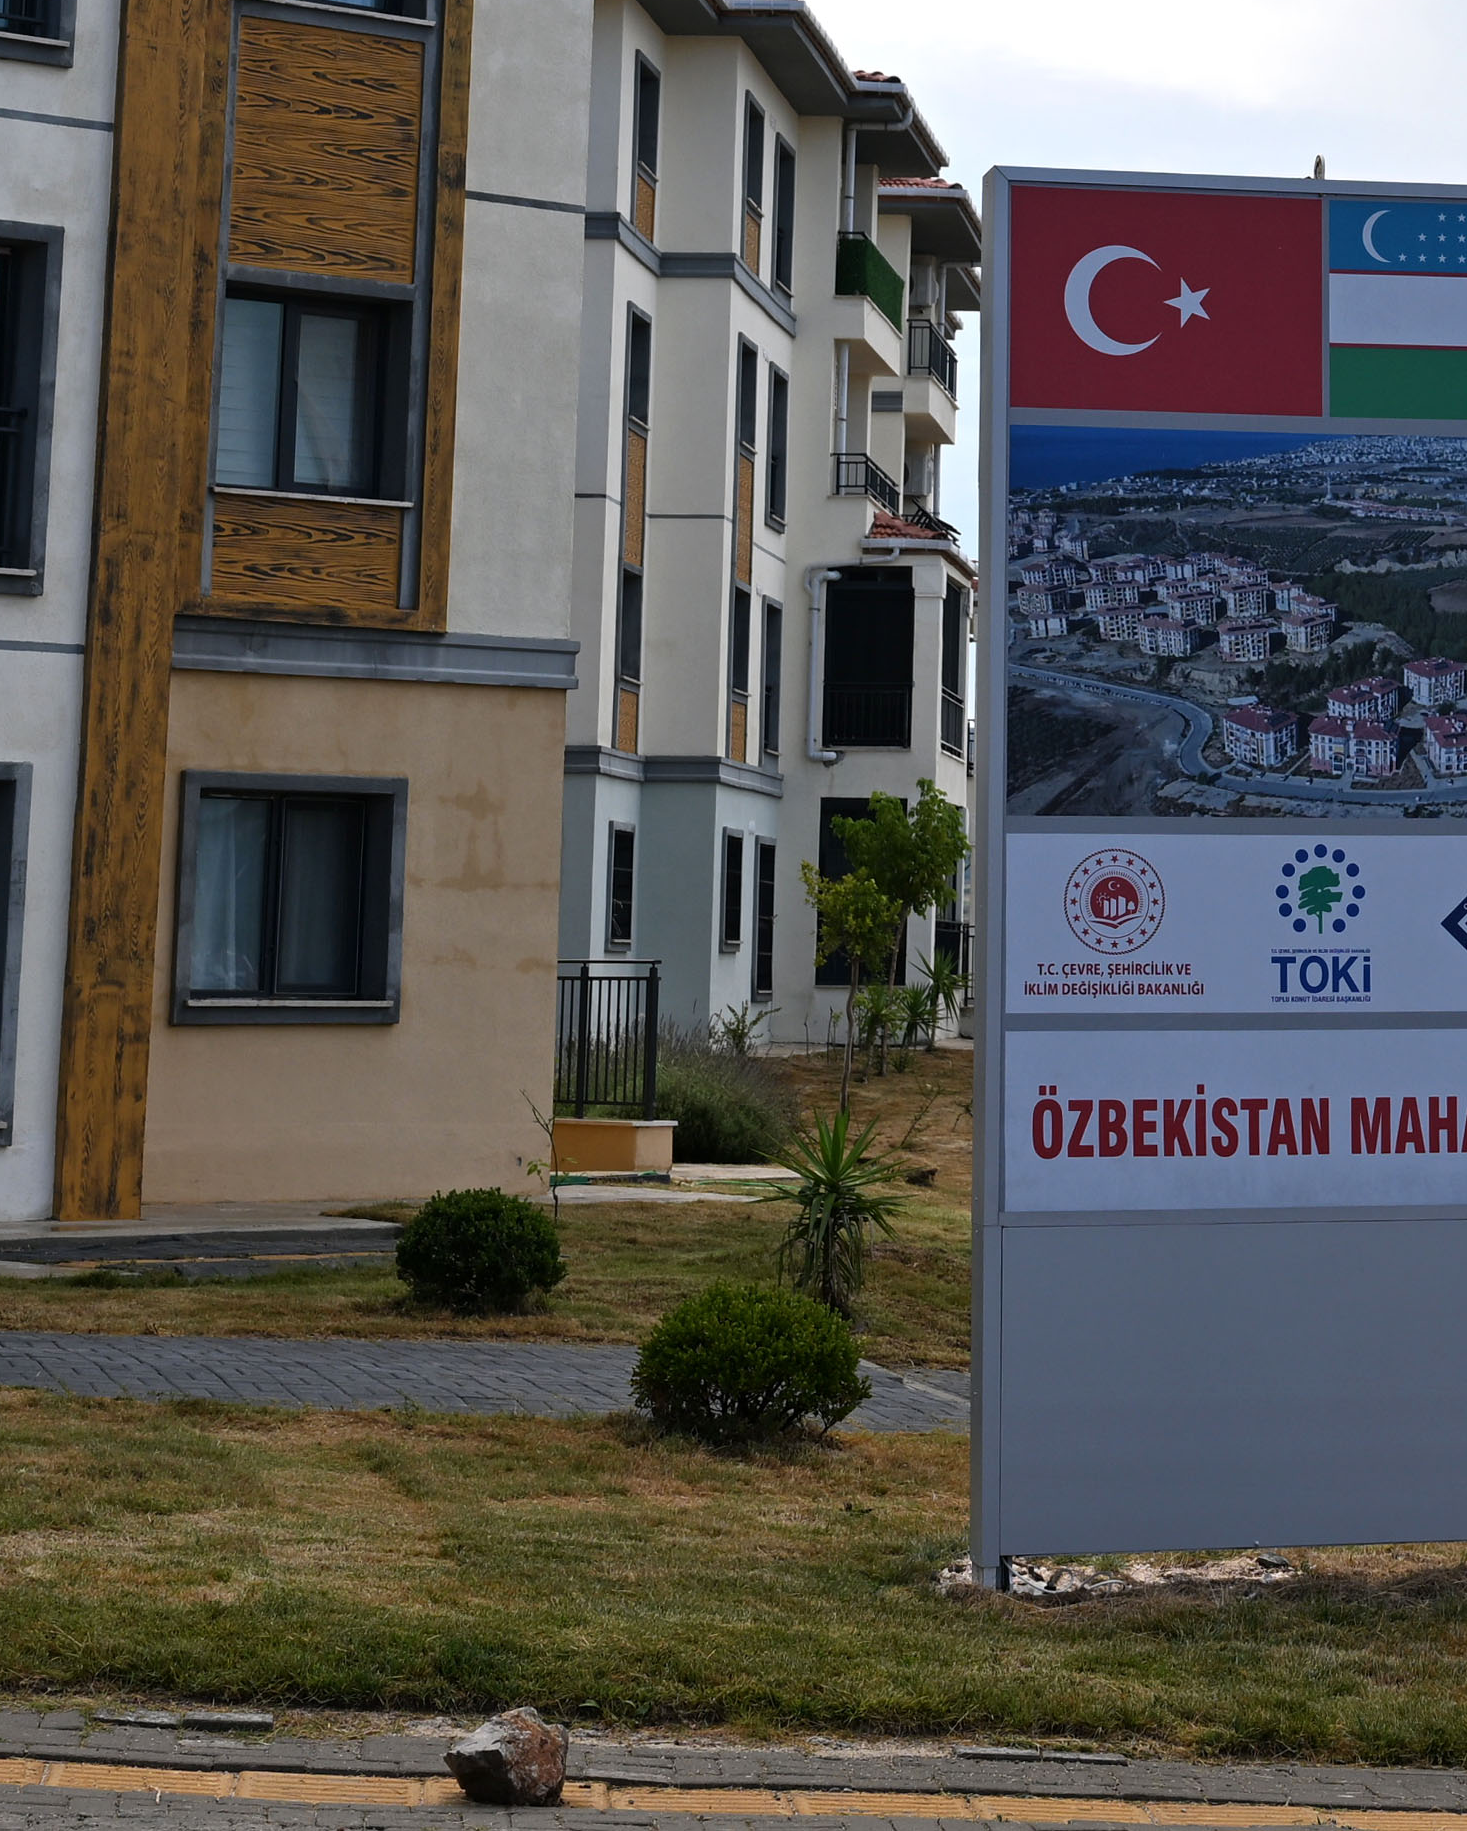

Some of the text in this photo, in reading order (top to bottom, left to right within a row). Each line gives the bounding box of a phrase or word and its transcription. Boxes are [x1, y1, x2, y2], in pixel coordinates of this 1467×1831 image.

[1037, 960, 1191, 978] T.C. ÇEVRE, ŞEHİRCİLİK VE
[1024, 980, 1204, 998] İKLİM DEĞİŞİKLİĞİ BAKANLIĞI
[1031, 1084, 1331, 1161] ÖZBEKİSTAN
